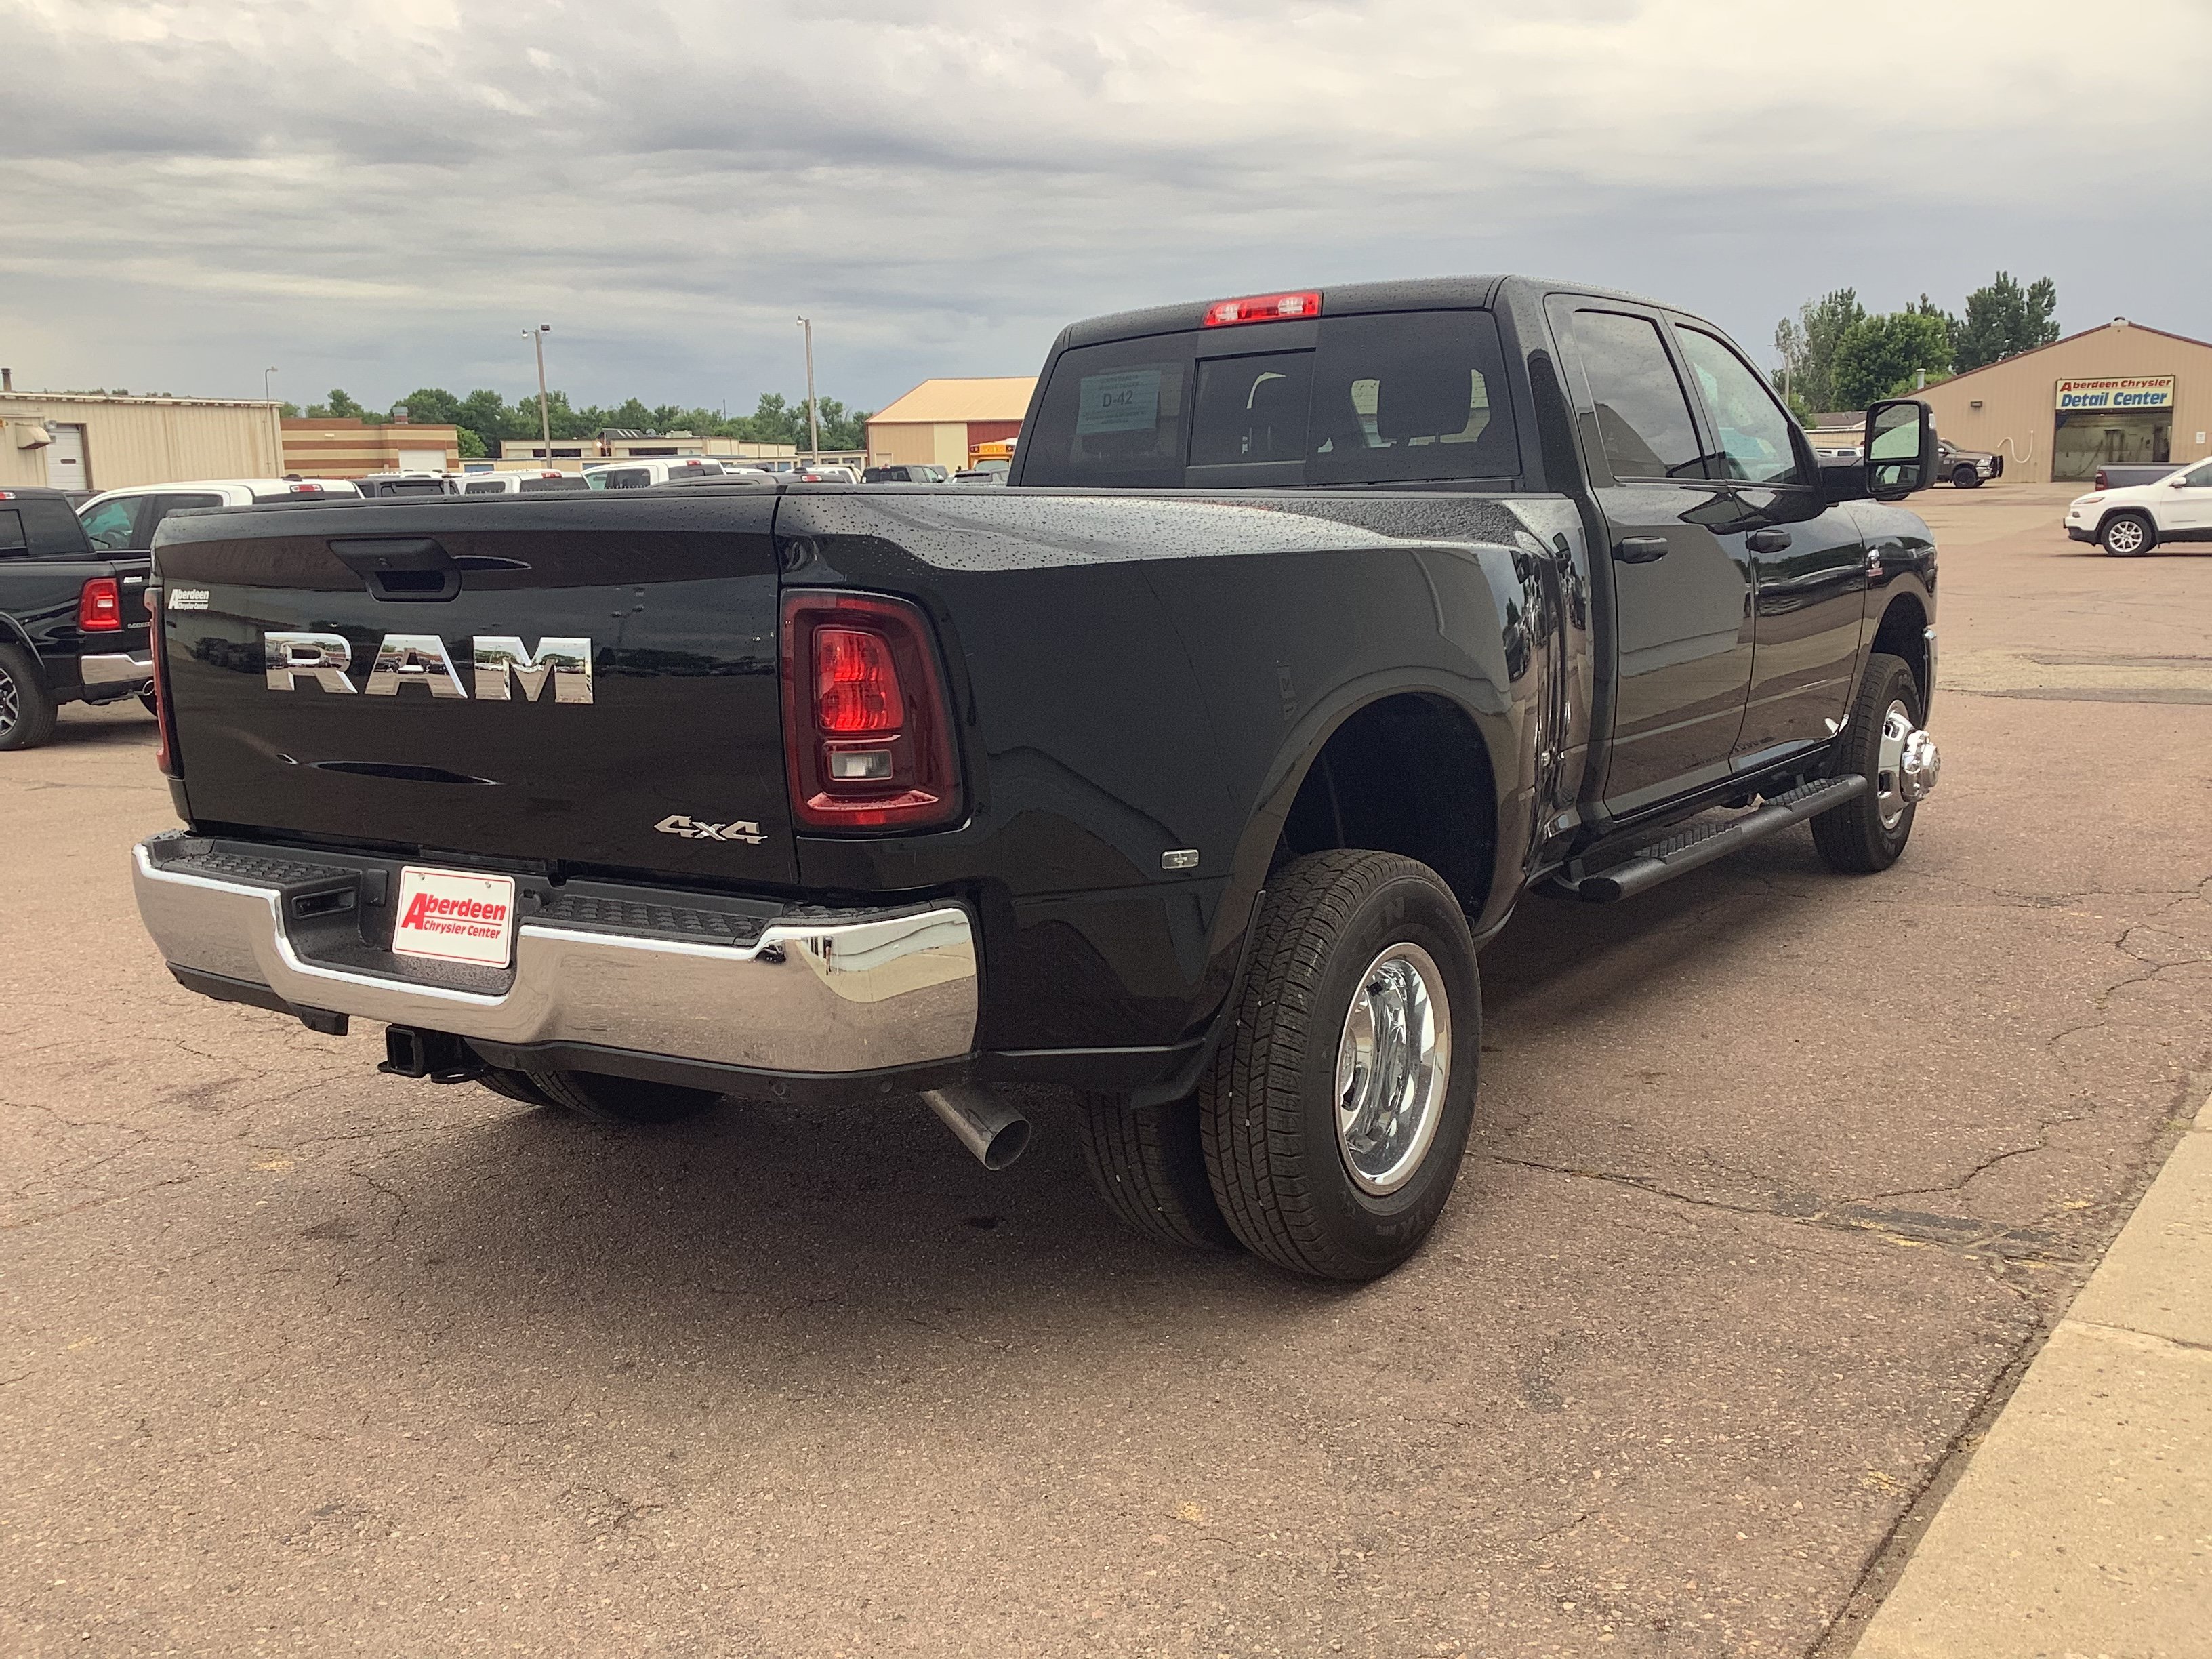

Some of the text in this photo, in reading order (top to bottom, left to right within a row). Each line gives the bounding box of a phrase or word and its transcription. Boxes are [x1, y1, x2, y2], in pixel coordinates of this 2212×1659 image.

[2060, 379, 2171, 392] Aberdeen Chrysler
[1102, 390, 1134, 408] D-42
[2061, 391, 2168, 407] Detail Center
[167, 588, 210, 610] Aberdeen
[264, 631, 594, 705] RAM
[401, 892, 507, 930] Aberdeen
[424, 920, 501, 939] Chrysler Center
